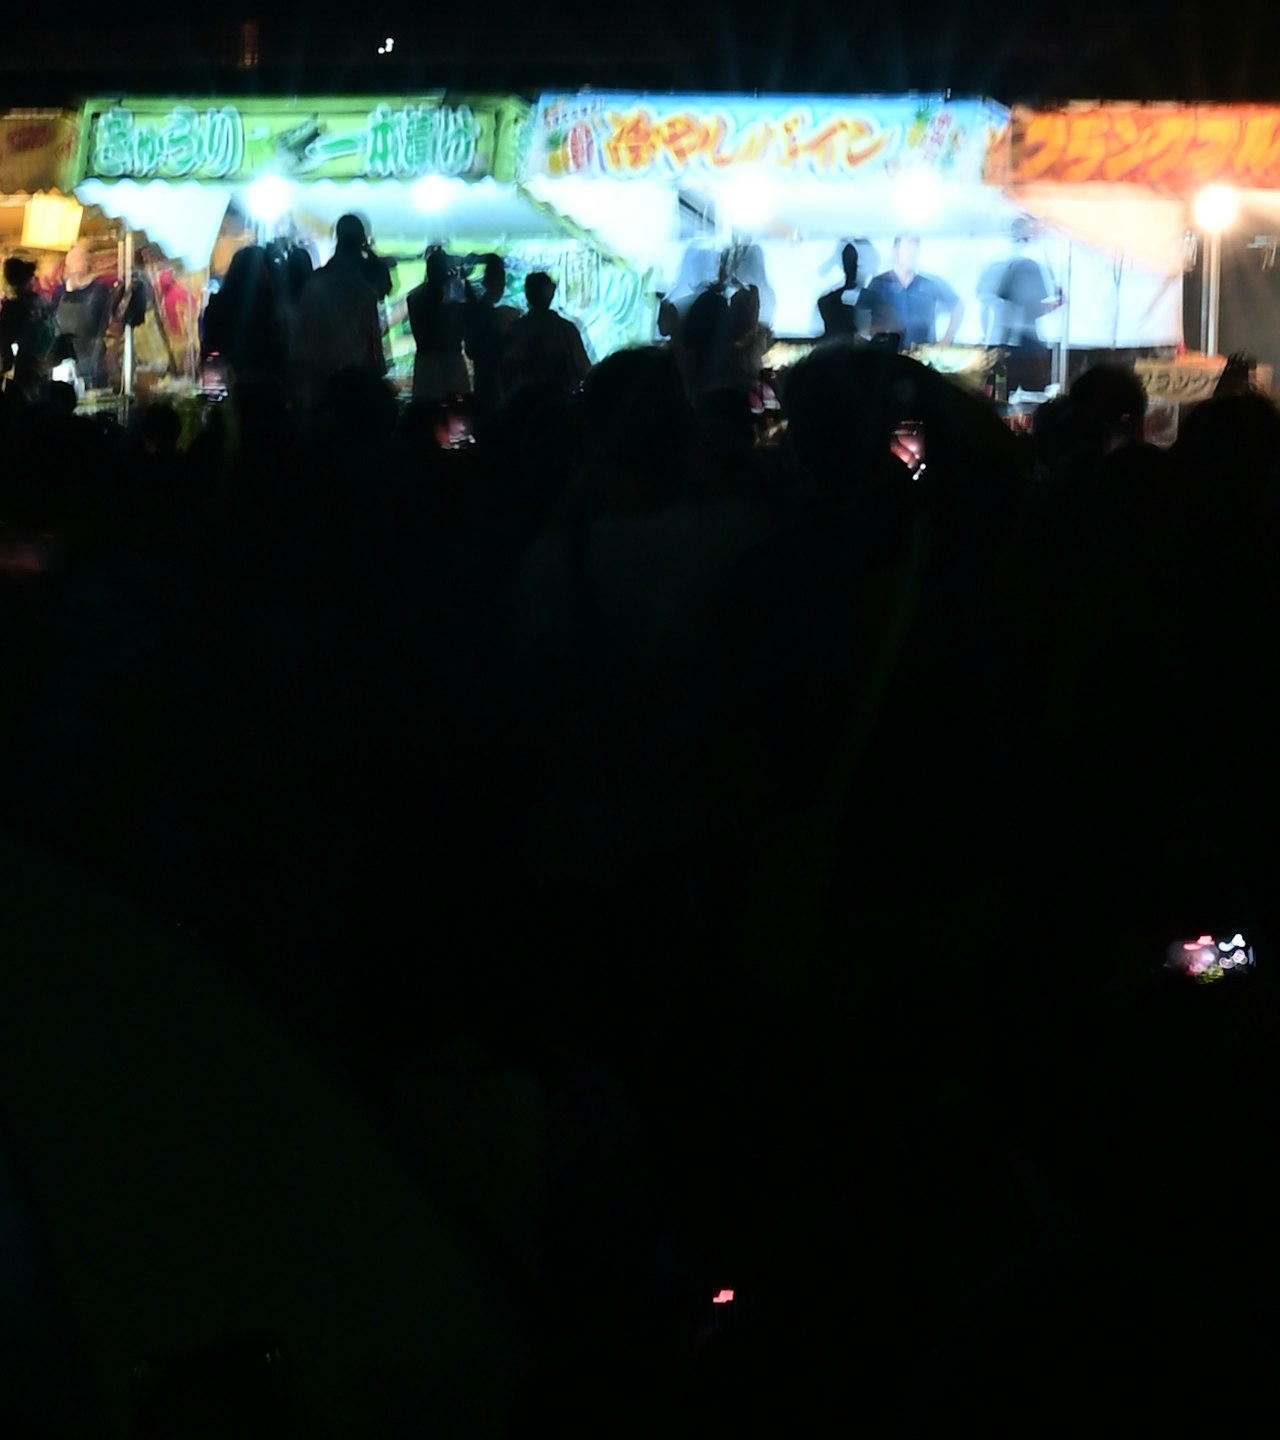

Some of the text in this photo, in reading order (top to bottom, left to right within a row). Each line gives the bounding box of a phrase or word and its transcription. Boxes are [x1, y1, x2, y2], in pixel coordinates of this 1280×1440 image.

[603, 108, 893, 174] 冷やしパイン
